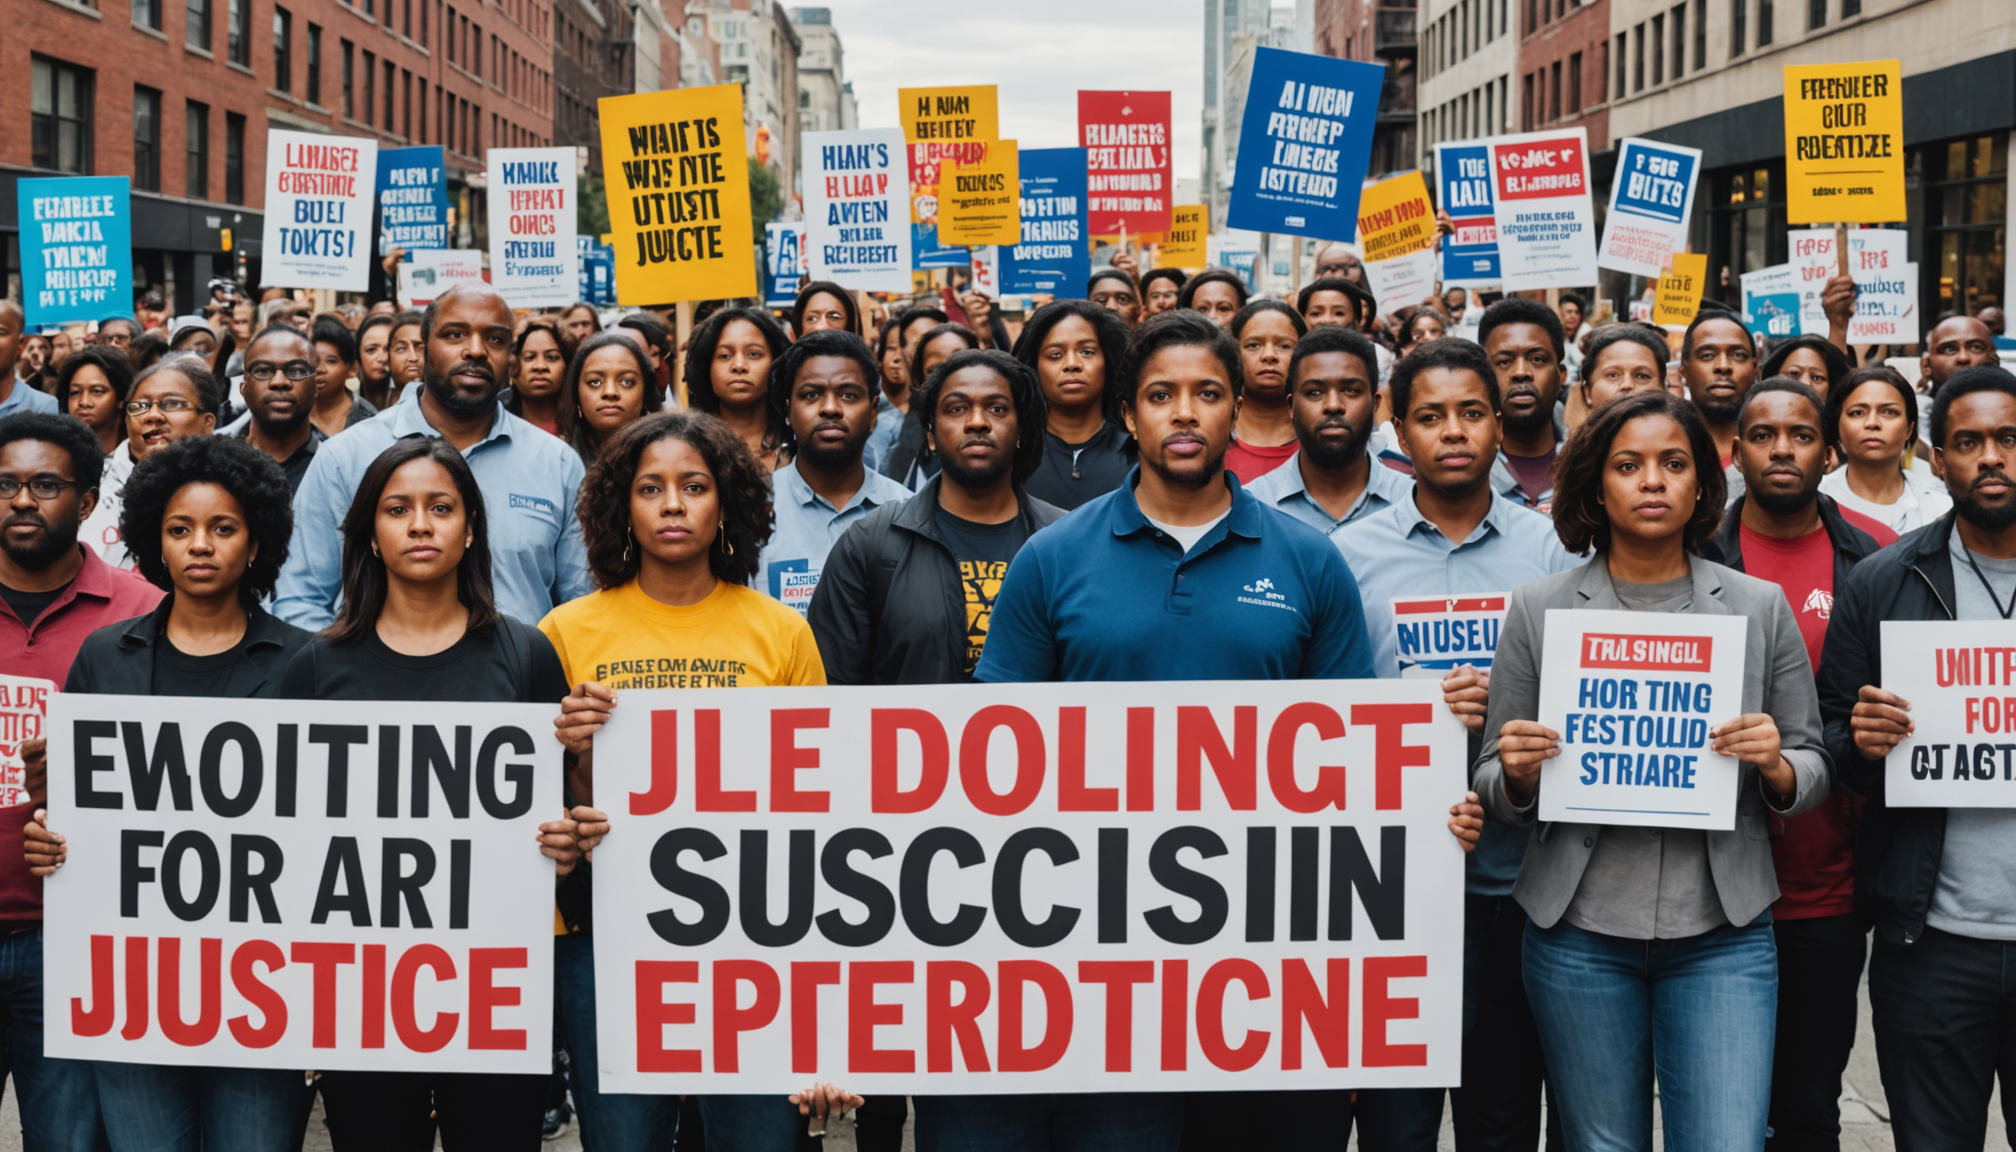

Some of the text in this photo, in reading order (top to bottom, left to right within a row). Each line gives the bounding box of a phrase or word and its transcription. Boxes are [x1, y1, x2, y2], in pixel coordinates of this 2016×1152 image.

[629, 708, 830, 815] JLE
[121, 830, 471, 929] FOR ARI
[71, 935, 527, 1053] JJUSTICE
